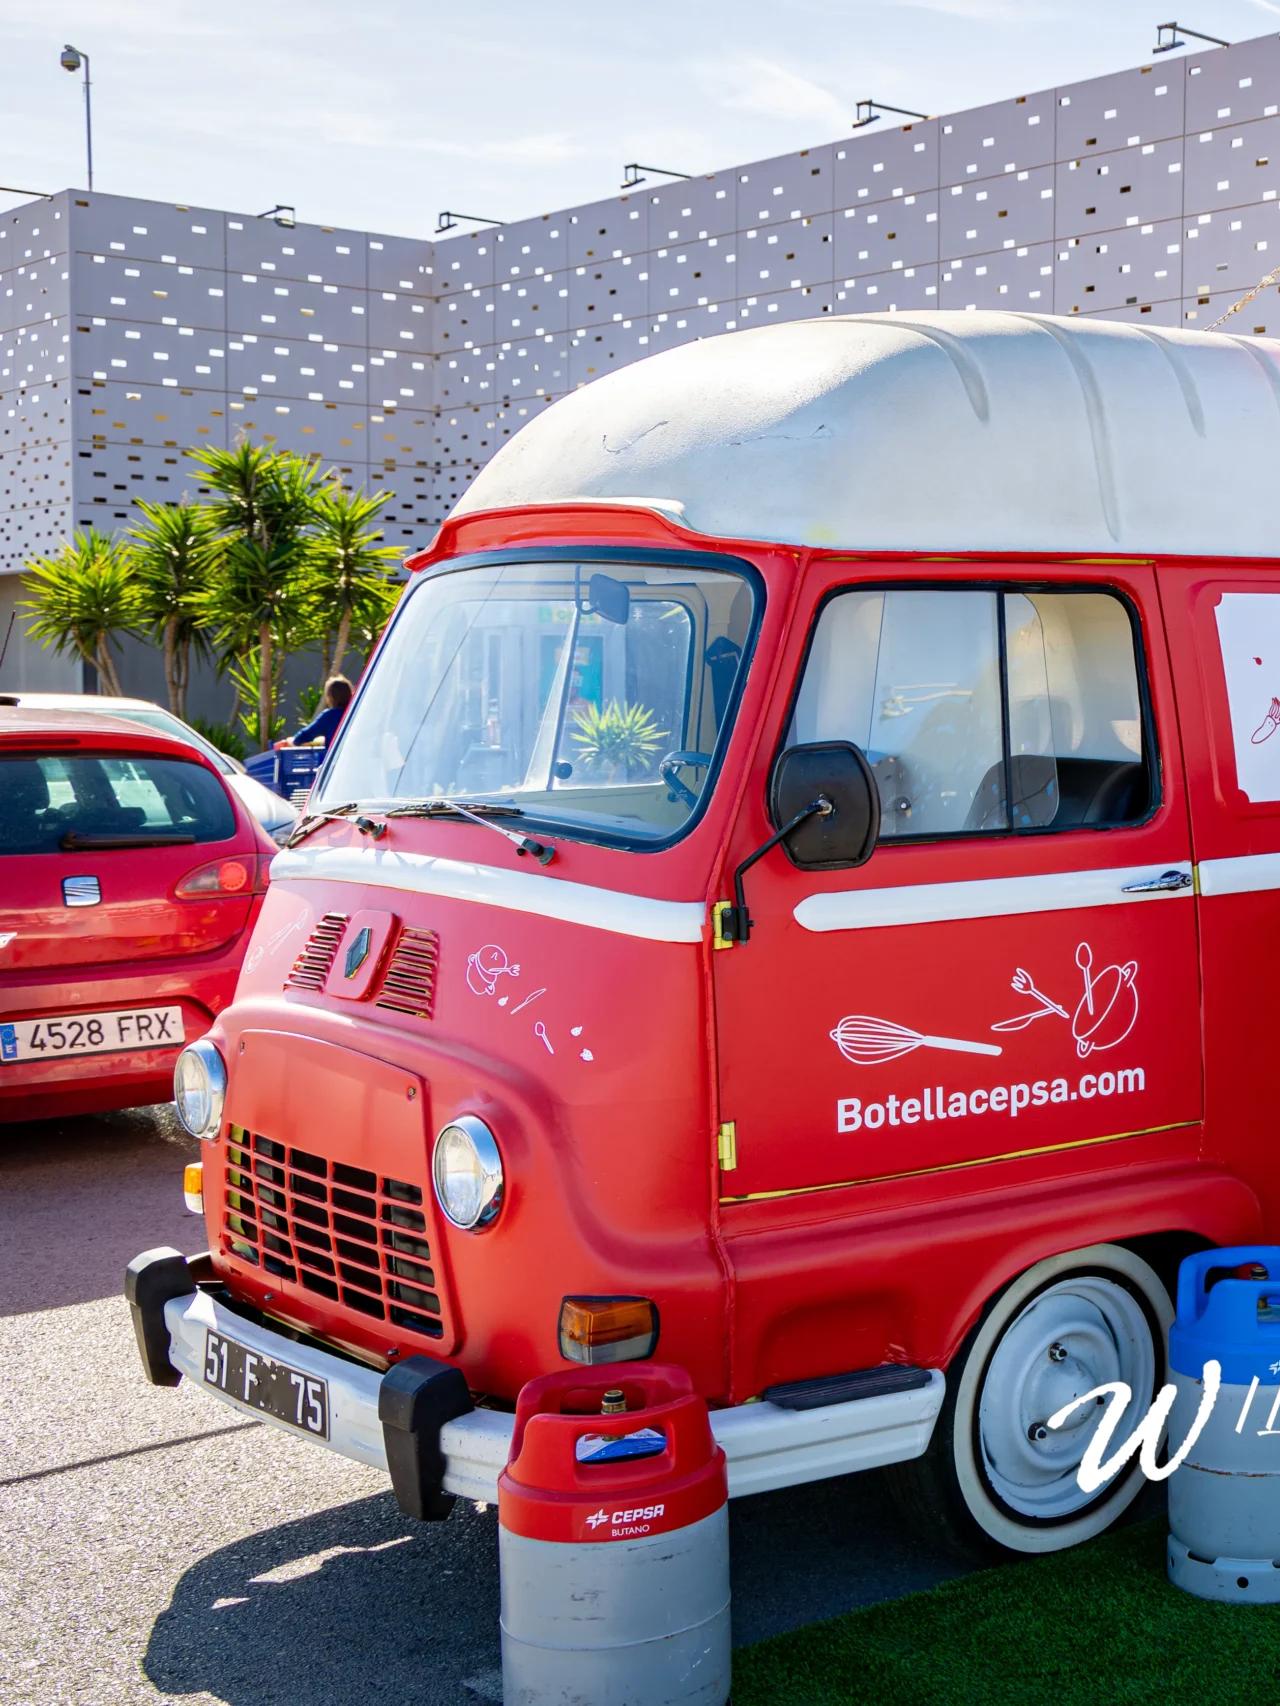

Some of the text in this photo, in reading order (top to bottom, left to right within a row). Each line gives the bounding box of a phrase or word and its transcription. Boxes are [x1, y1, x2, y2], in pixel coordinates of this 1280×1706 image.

[29, 1018, 105, 1052] 4528
[116, 1011, 173, 1043] FRX
[837, 1067, 1146, 1133] Botellacepsa.com
[206, 1332, 323, 1433] 51 F 75
[611, 1503, 665, 1525] CEPSA
[611, 1524, 650, 1537] BUTANO
